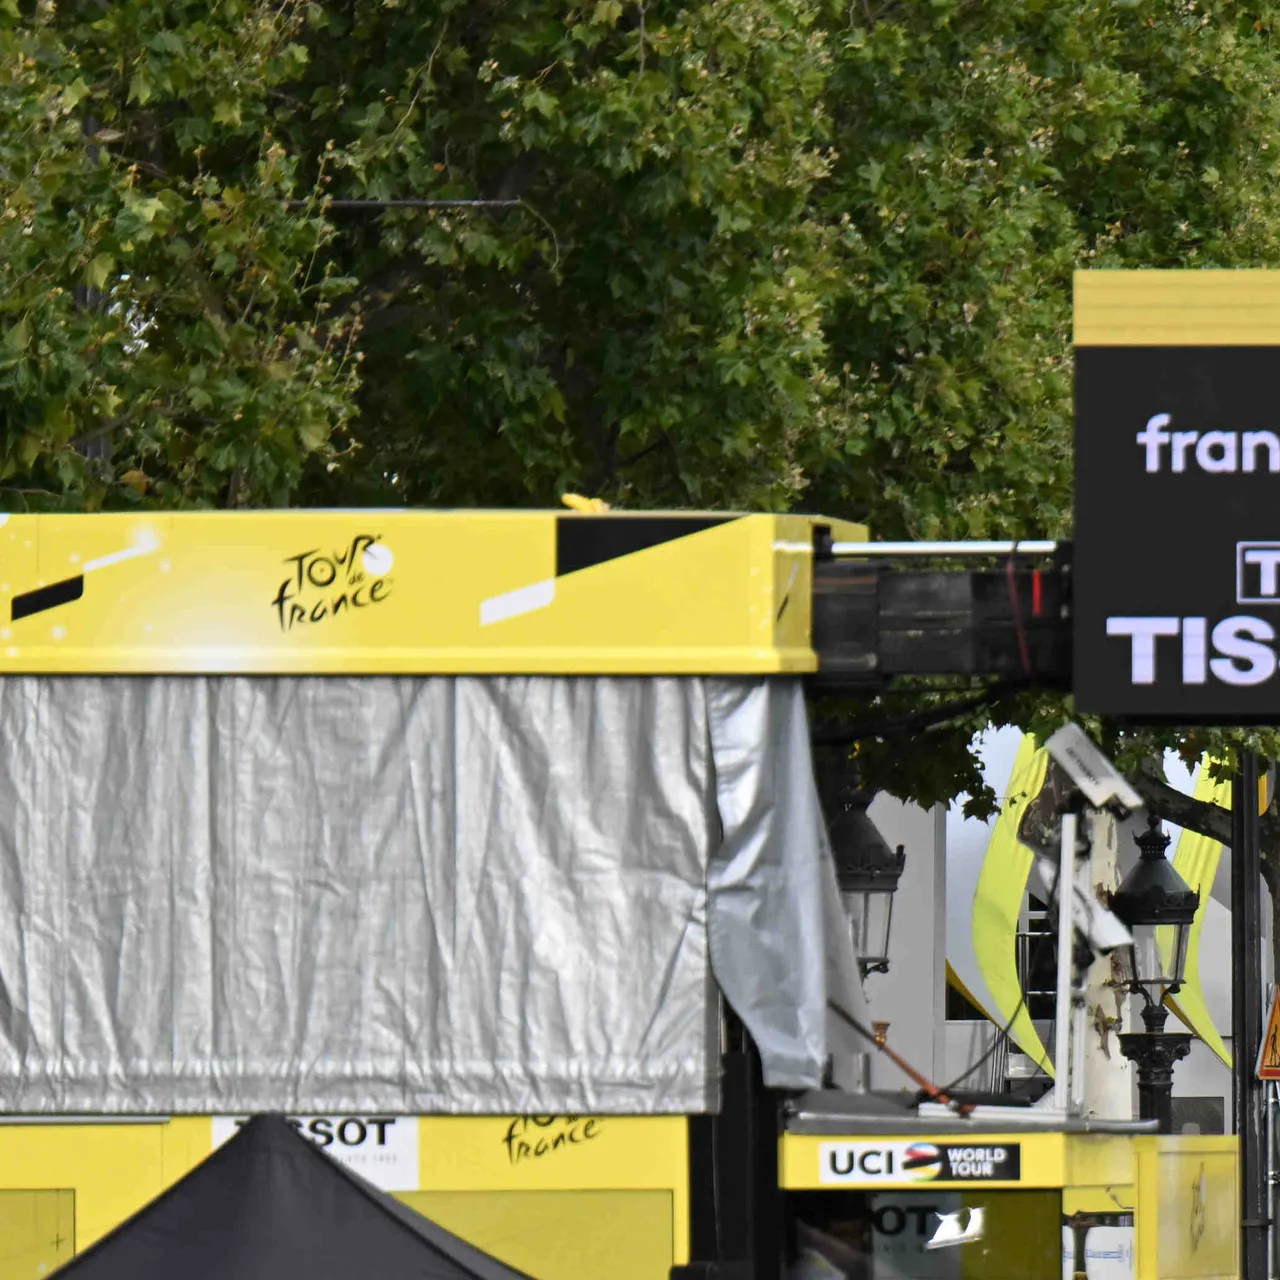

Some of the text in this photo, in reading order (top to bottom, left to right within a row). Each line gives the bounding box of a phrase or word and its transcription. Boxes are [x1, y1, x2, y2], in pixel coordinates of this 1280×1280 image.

[290, 534, 383, 590] TOUR
[272, 576, 394, 632] france
[829, 1150, 894, 1176] UCI
[947, 1147, 1006, 1163] WORLD
[950, 1162, 995, 1178] TOUR
